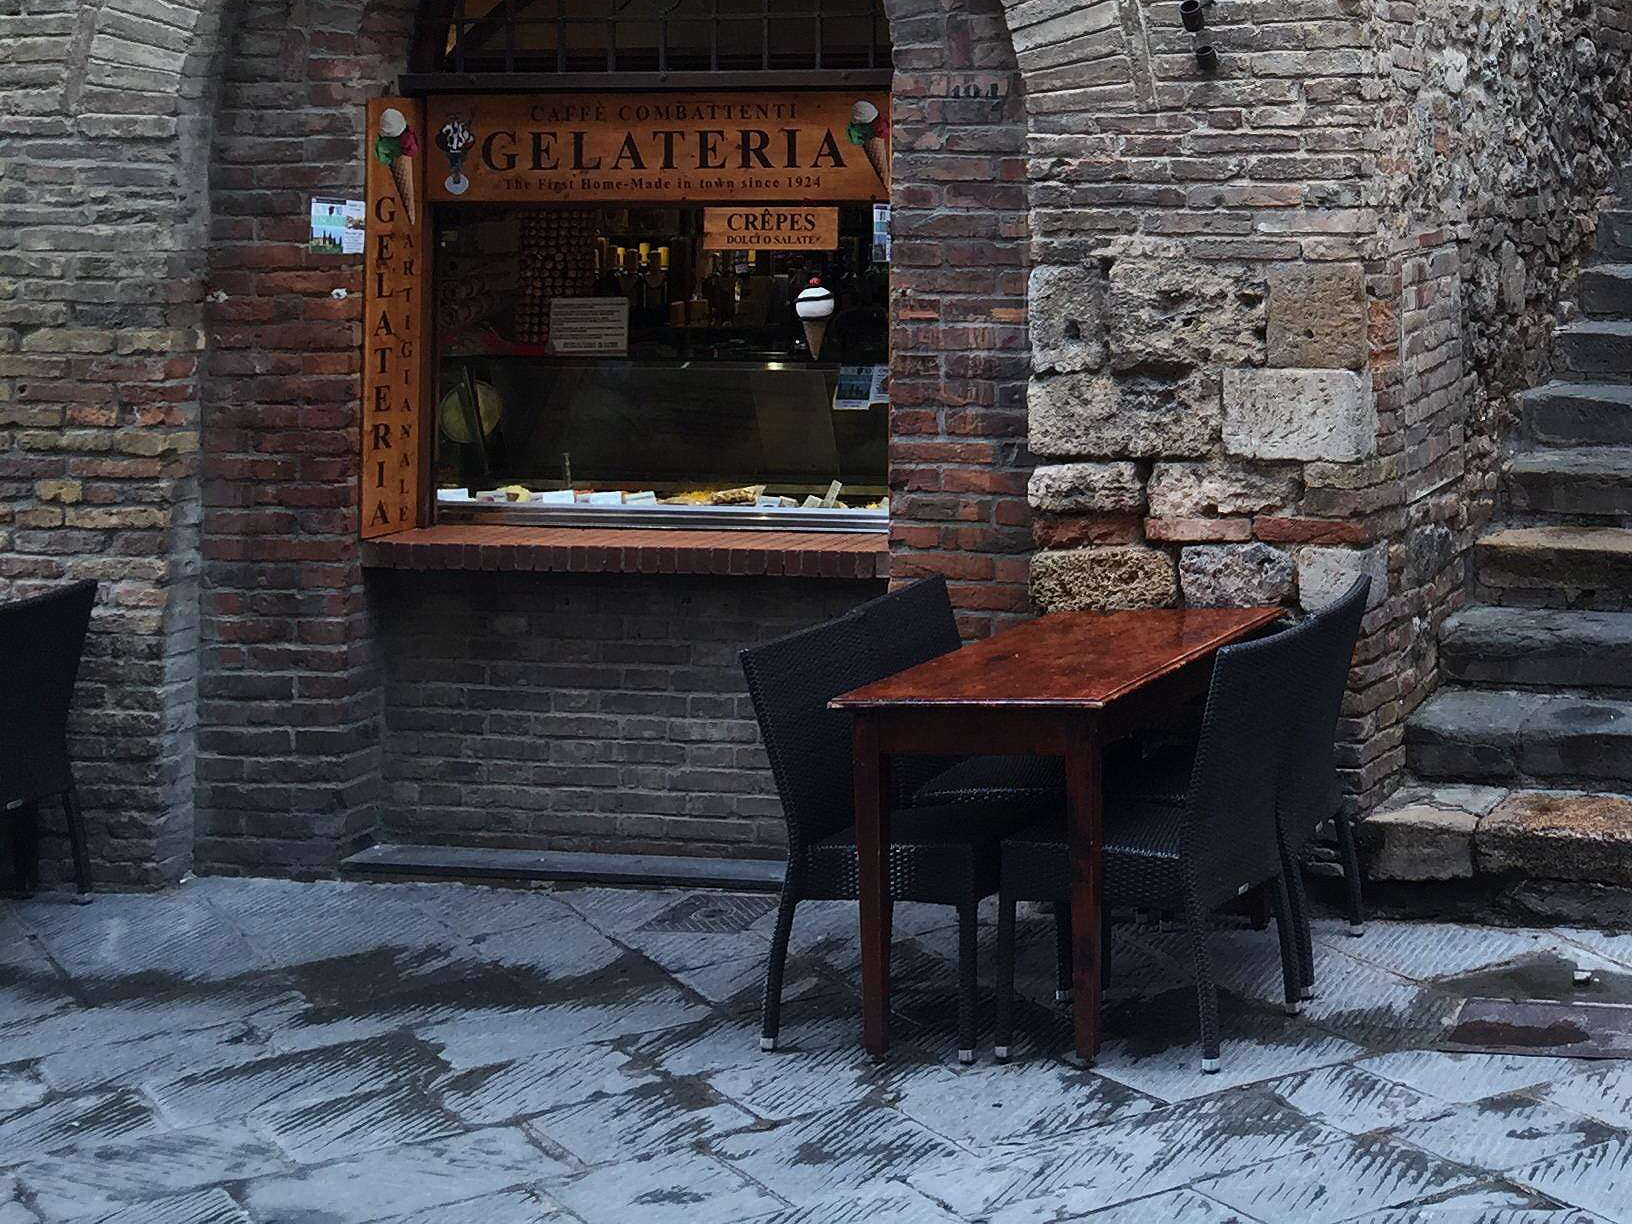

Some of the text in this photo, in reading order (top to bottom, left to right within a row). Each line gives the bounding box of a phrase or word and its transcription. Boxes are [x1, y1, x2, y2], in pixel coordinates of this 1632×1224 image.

[530, 102, 799, 123] CAFFÈ COMBATTENTI
[481, 127, 848, 172] GELATERIA
[504, 176, 821, 190] The First Home-Made in town since 1924
[727, 208, 816, 232] CRÊPES
[727, 235, 760, 245] DOLCI
[763, 235, 772, 245] O
[371, 195, 396, 525] GELATERIA
[398, 231, 415, 522] ARTIGIANALE
